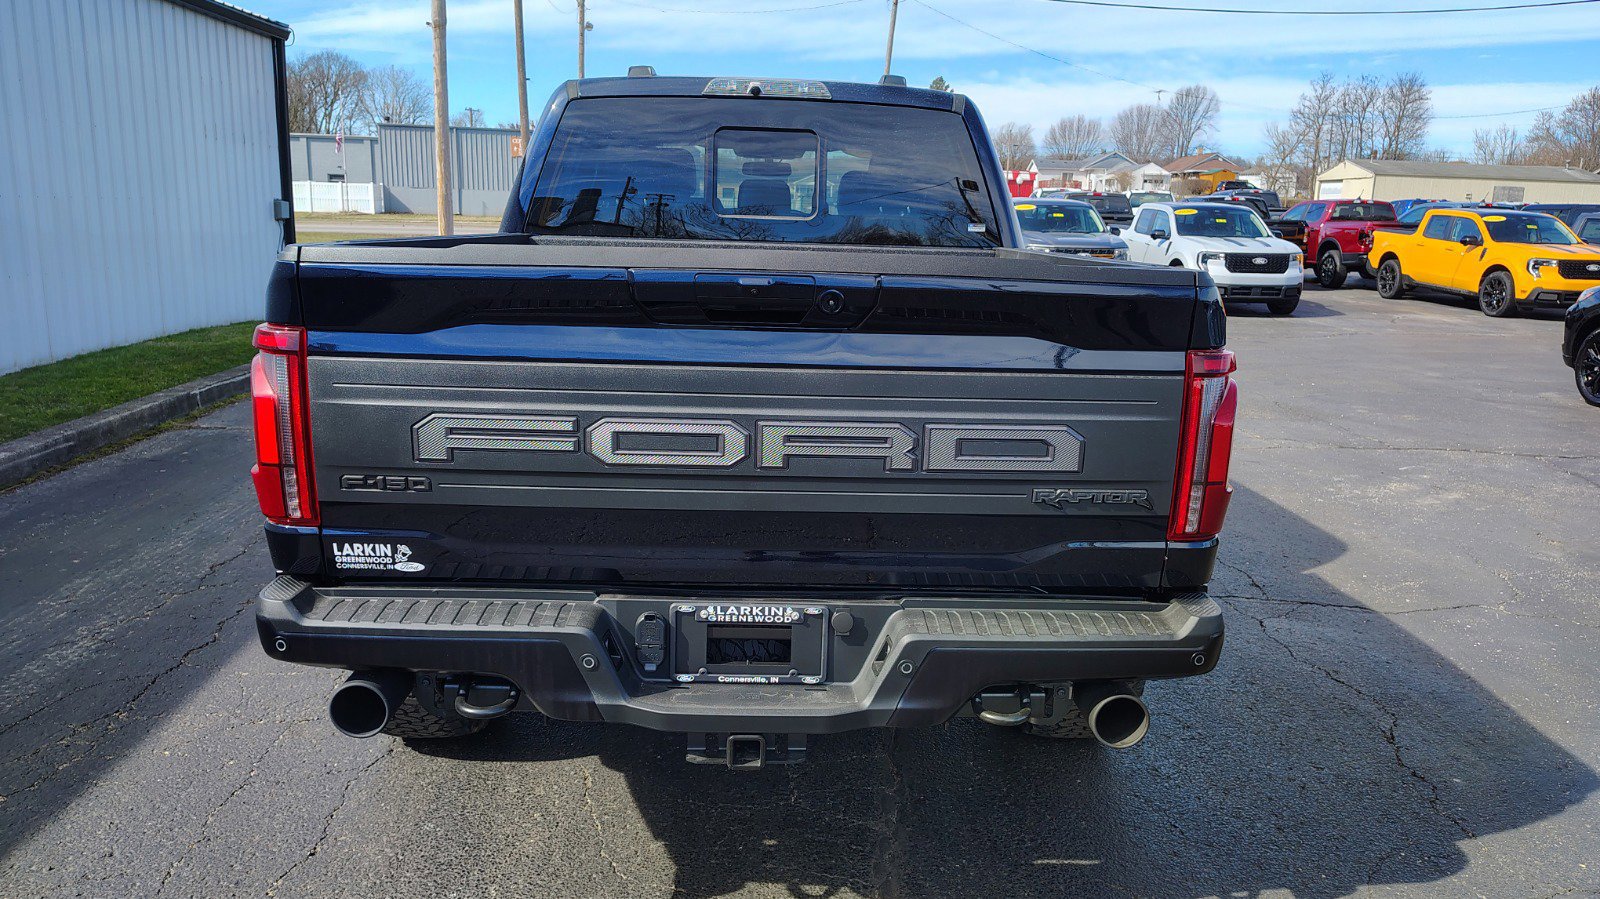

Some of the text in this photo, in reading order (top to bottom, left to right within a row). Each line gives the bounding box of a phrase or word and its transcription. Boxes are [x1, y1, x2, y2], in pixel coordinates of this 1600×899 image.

[412, 412, 1086, 474] FORD
[1032, 488, 1153, 510] RAPTOR
[332, 542, 392, 557] LARKIN
[716, 605, 783, 616] LARKIN
[707, 614, 793, 623] GREENEWOOD
[717, 675, 768, 684] Connersville,
